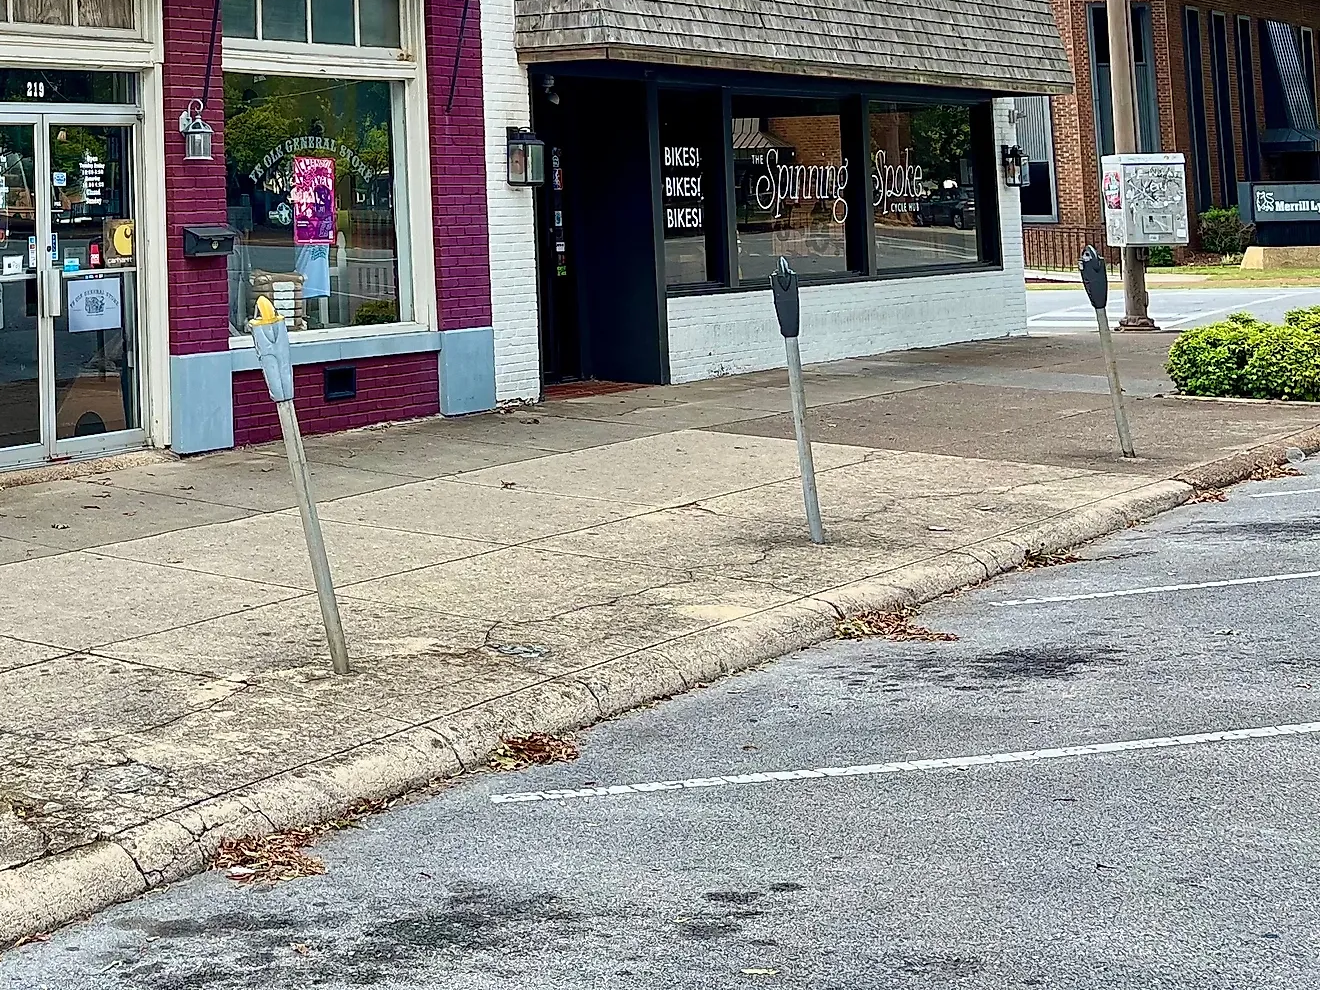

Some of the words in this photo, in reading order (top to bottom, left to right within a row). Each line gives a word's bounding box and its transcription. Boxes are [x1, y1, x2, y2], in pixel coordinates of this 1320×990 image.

[26, 81, 45, 98] 219
[248, 163, 265, 184] YE
[263, 144, 284, 168] OLE
[285, 136, 337, 153] GENERAL
[339, 144, 374, 183] STORE
[664, 146, 700, 167] BIKES!
[751, 154, 764, 165] THE
[665, 176, 701, 197] BIKES!
[756, 148, 849, 224] Spinning
[871, 148, 923, 215] Spoke
[890, 202, 907, 213] CYCLE
[908, 202, 920, 212] HUB
[1274, 200, 1310, 212] Merrill
[666, 207, 702, 228] BIKES!
